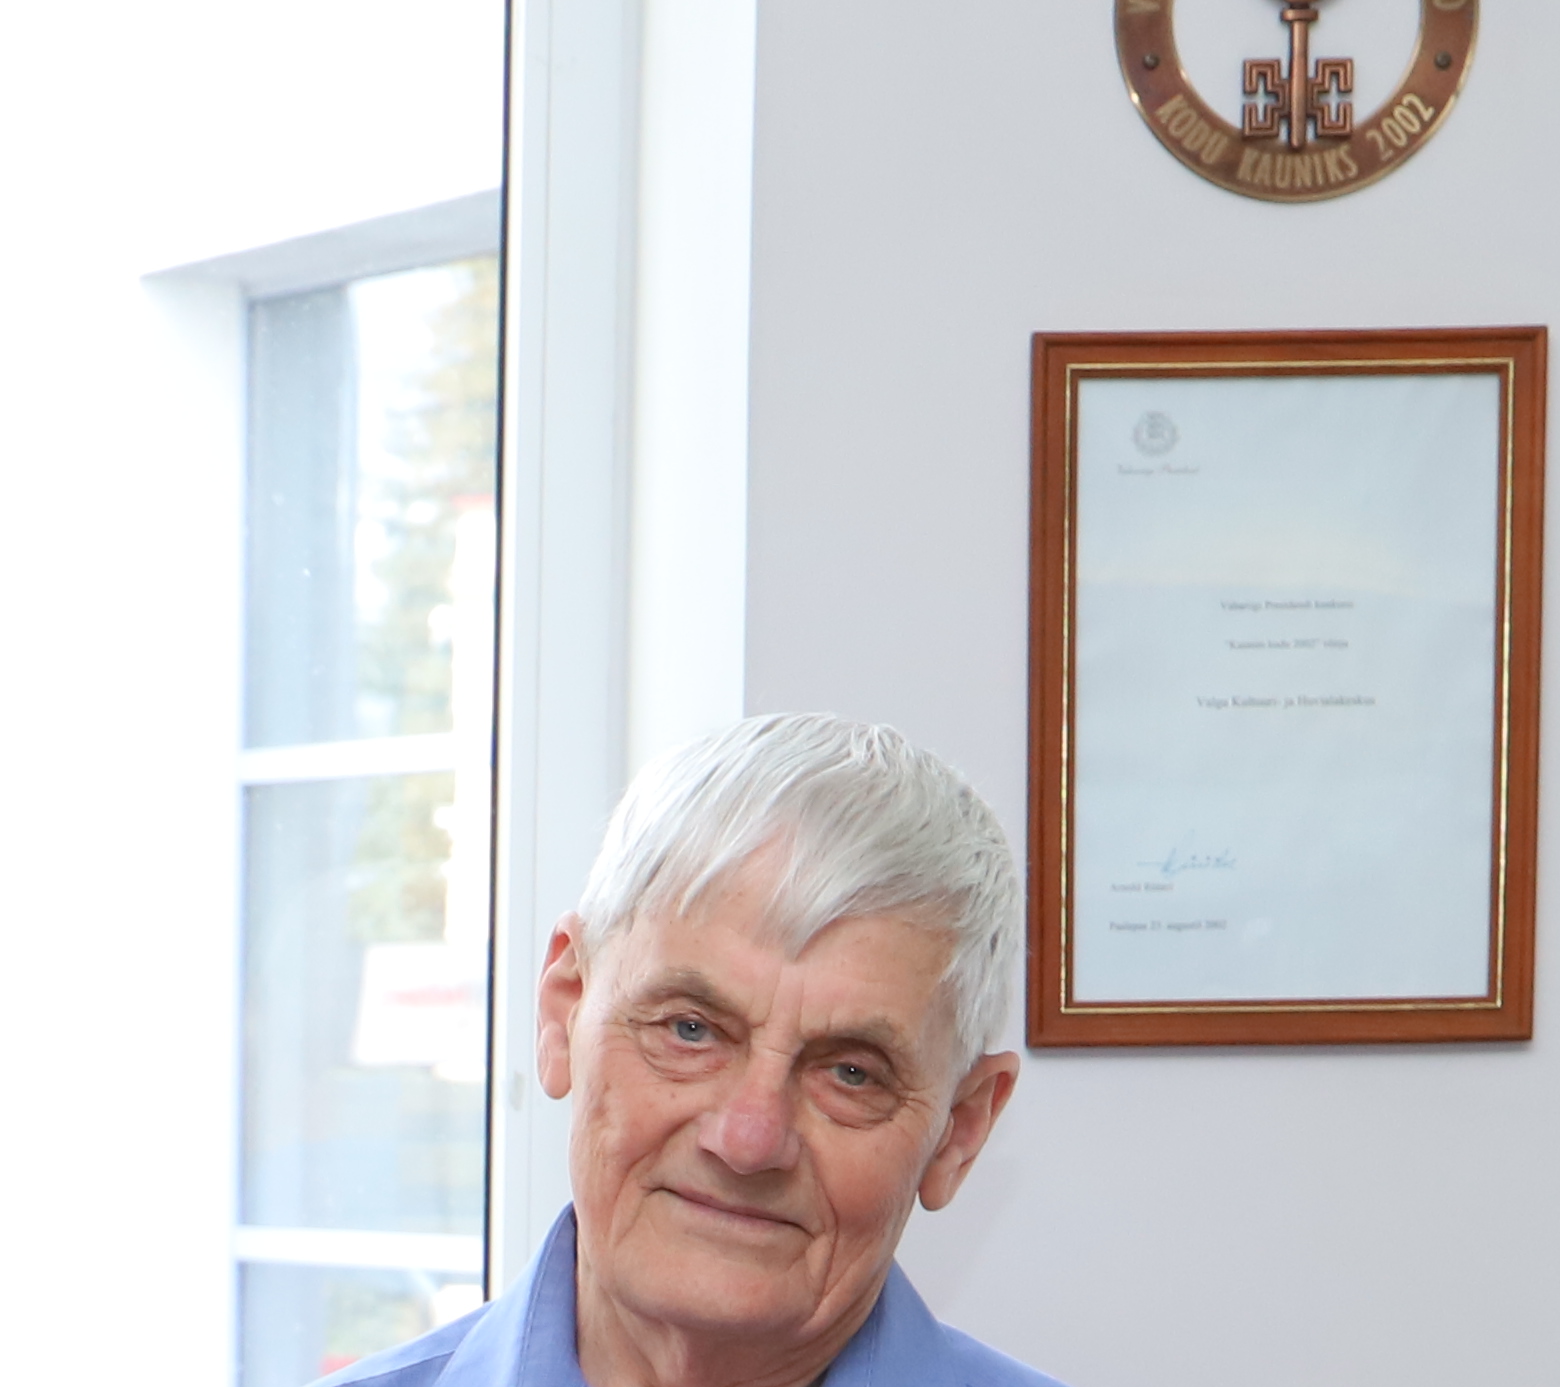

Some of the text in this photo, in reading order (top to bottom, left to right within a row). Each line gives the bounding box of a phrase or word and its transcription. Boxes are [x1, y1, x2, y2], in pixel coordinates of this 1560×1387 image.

[1154, 92, 1434, 188] KODU KAUNIKS 2002
